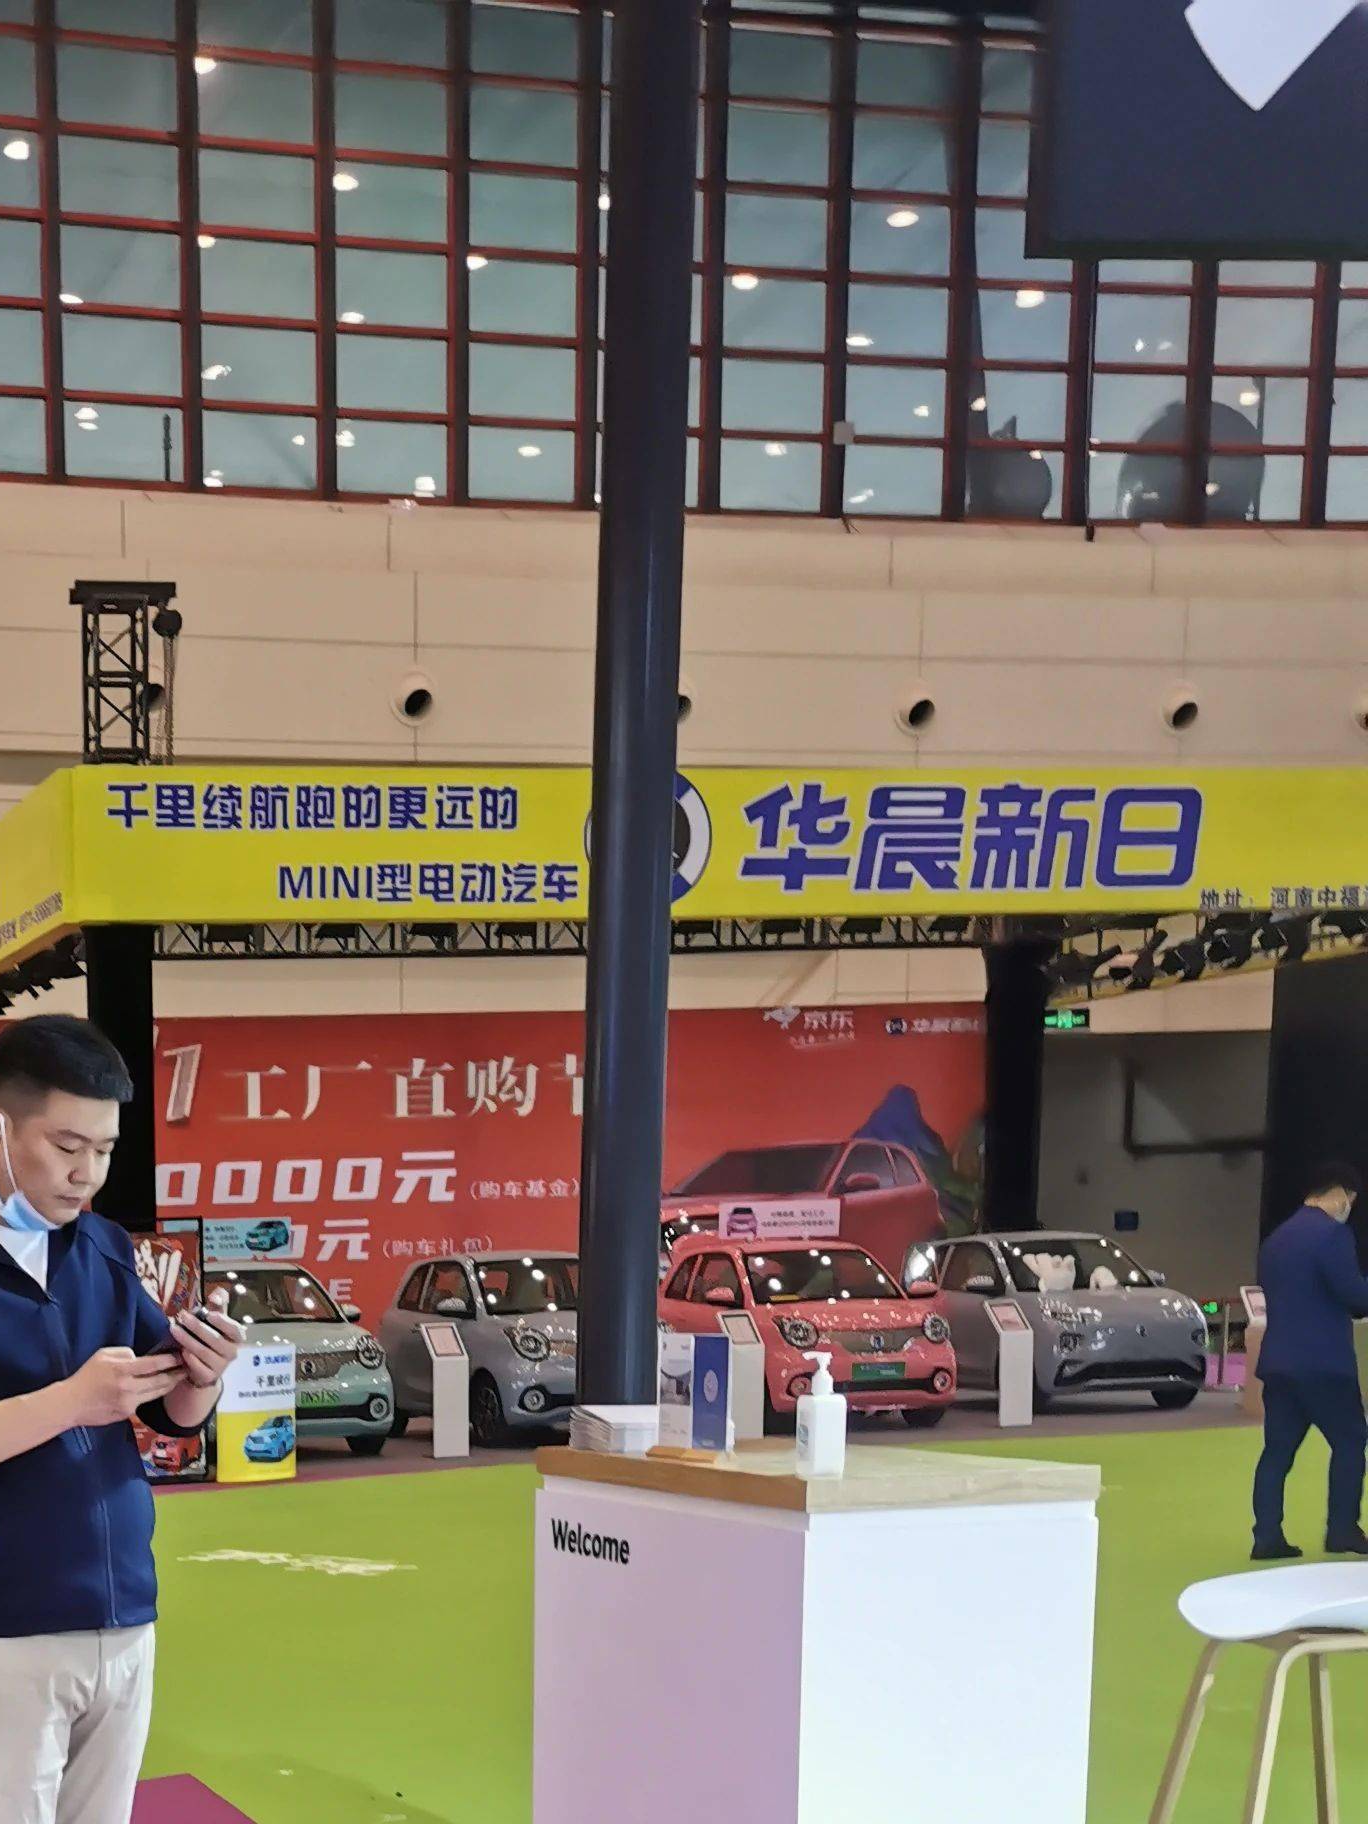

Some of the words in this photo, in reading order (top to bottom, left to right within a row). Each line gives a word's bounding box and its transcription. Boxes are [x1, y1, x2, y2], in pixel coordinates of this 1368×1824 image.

[106, 784, 518, 831] 千里续航跑的更远的
[740, 784, 1203, 890] 华晨新日
[278, 862, 579, 903] MINI型电动汽车
[551, 1518, 630, 1565] Welcome
